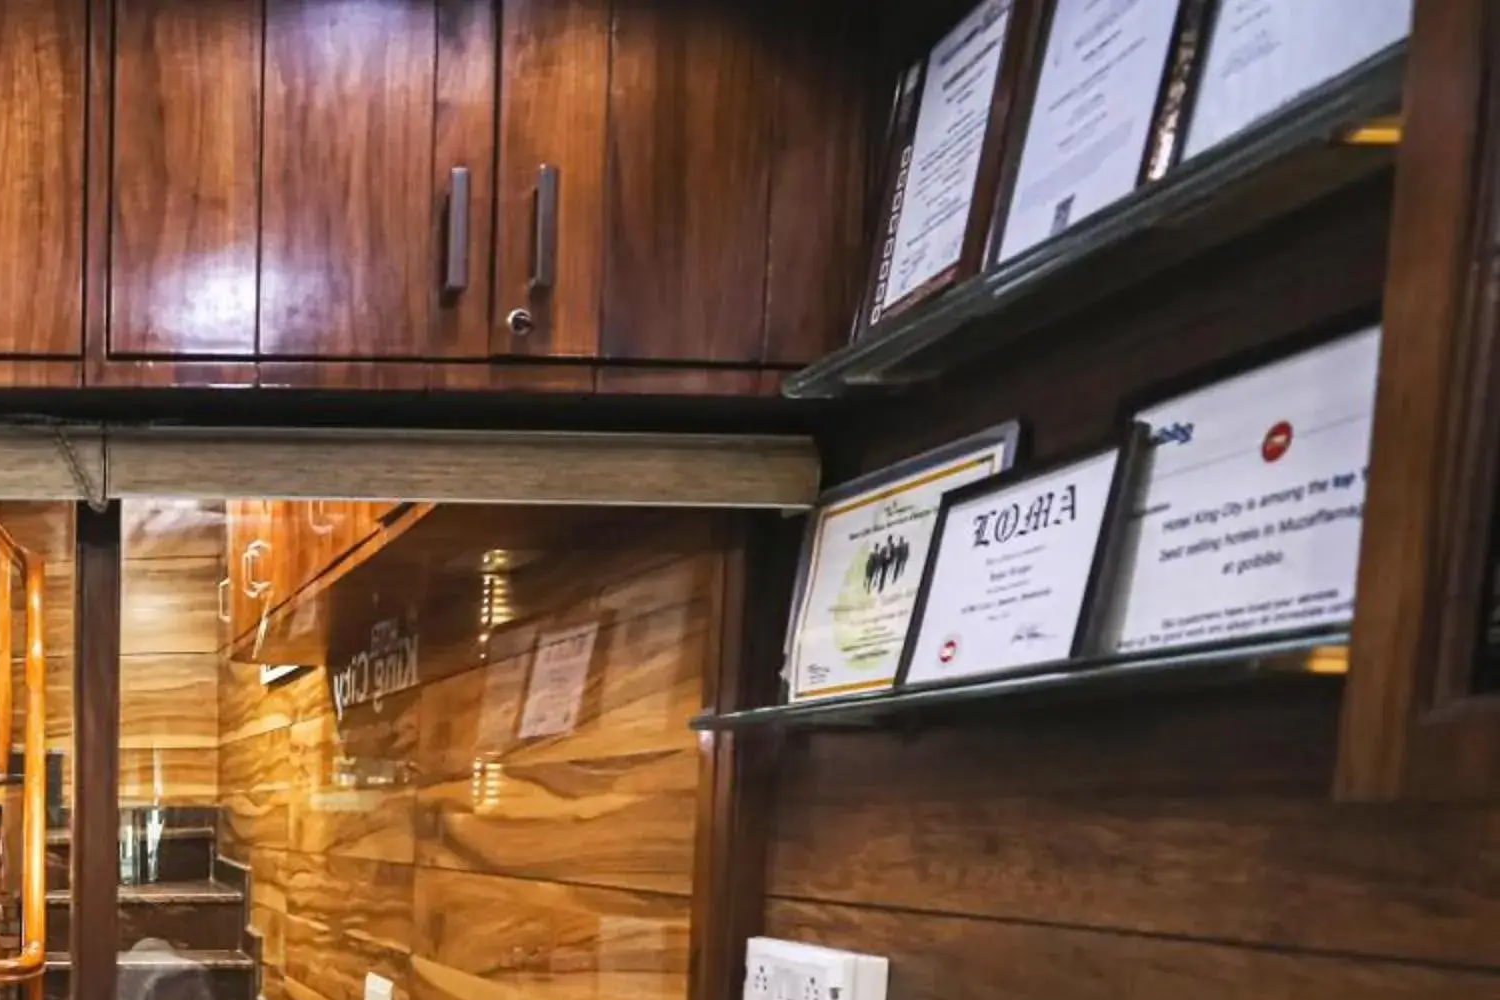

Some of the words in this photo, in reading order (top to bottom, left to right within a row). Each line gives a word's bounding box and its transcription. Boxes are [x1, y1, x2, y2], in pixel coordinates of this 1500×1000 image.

[1194, 508, 1220, 526] King
[1220, 501, 1243, 518] City
[1246, 496, 1256, 511] is
[1260, 485, 1305, 508] among
[1307, 479, 1329, 495] the
[1332, 471, 1356, 490] top
[1186, 537, 1221, 556] selling
[1225, 527, 1260, 545] hotels
